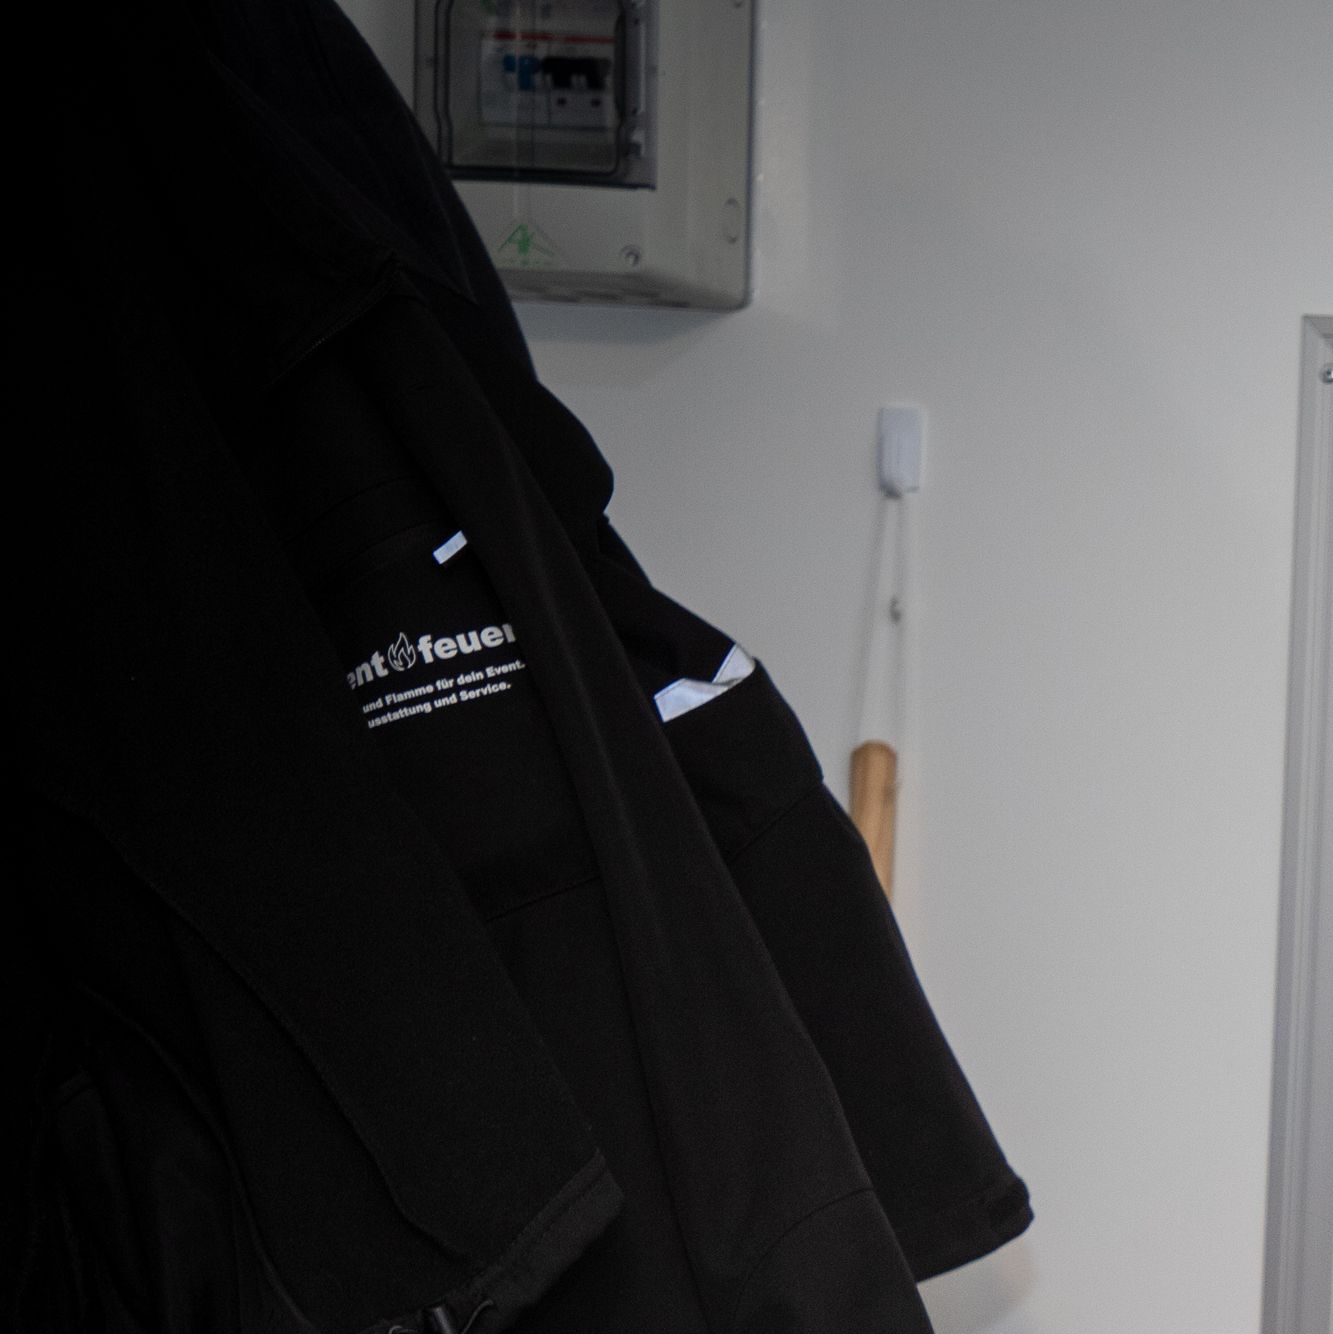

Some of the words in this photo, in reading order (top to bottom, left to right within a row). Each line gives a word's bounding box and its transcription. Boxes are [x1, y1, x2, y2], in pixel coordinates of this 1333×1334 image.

[362, 697, 384, 714] und
[384, 683, 435, 706] Flamme
[435, 677, 455, 691] für
[456, 670, 485, 686] dein
[433, 693, 458, 709] und
[459, 681, 512, 702] Service.
